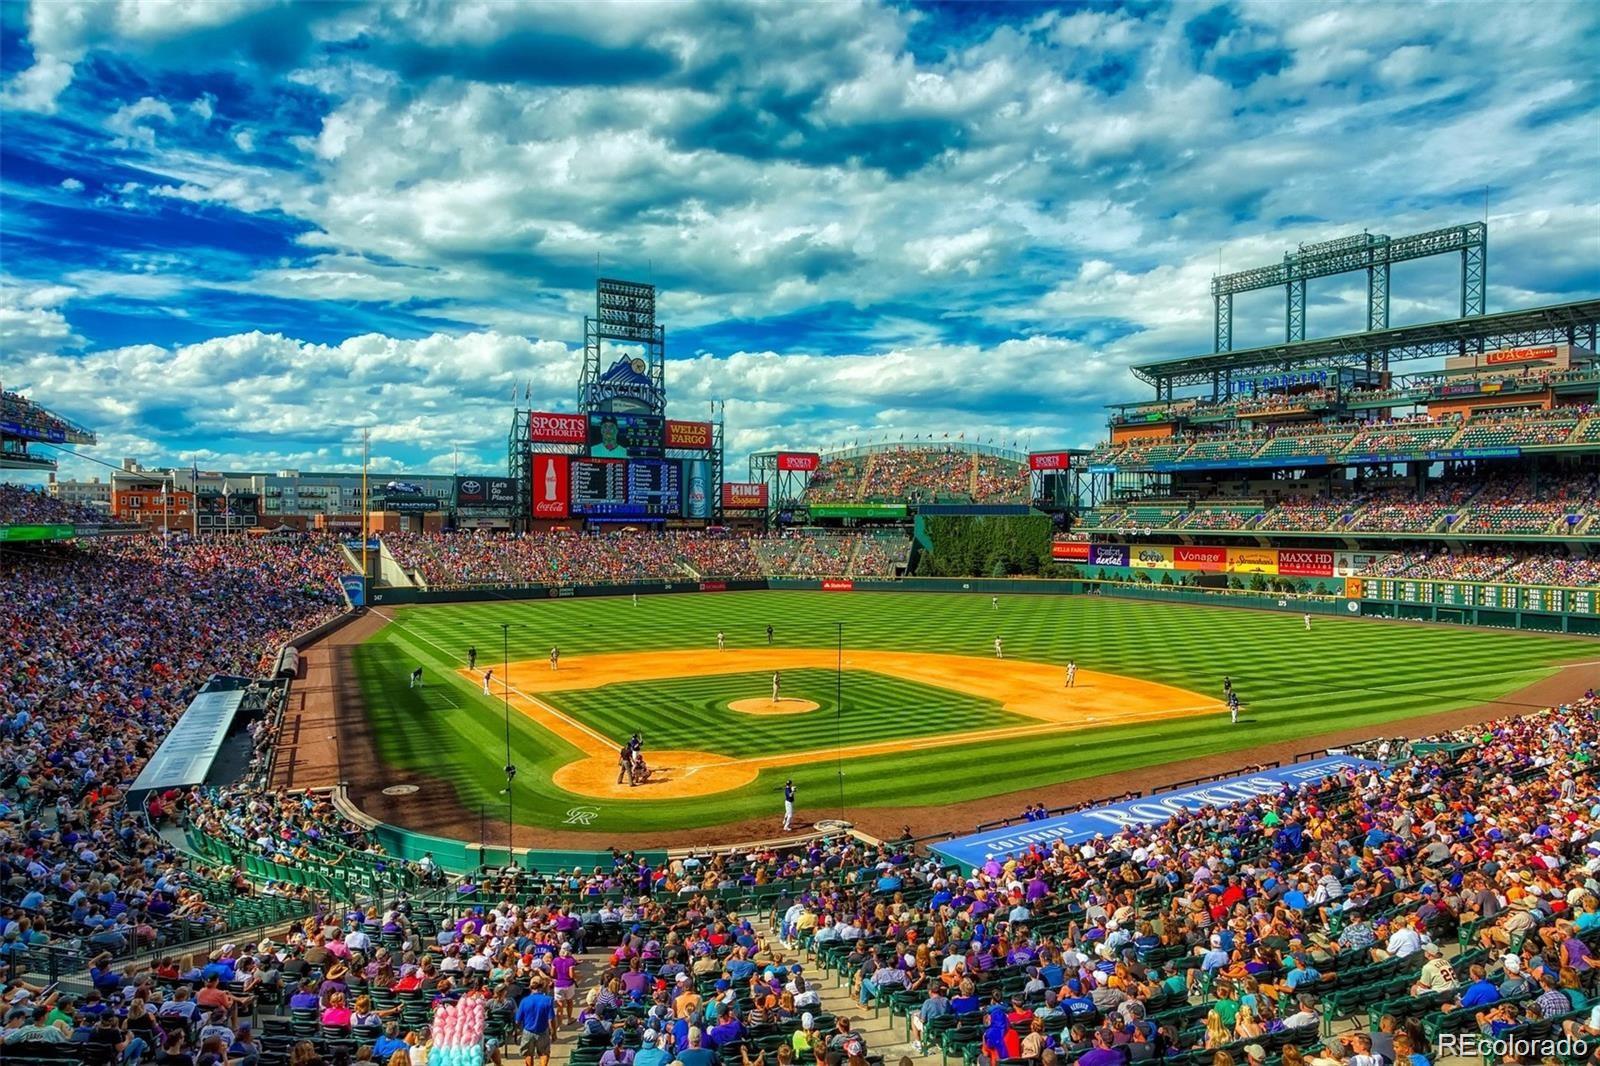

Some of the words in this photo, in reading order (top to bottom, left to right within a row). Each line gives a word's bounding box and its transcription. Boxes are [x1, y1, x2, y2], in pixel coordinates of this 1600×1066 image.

[1489, 349, 1535, 361] TUACA
[585, 383, 668, 408] ROCKIES
[532, 416, 585, 430] SPORTS
[532, 428, 585, 437] AUTHORITY
[671, 425, 706, 435] WELLS
[671, 434, 706, 445] FARGO
[786, 457, 811, 465] SPORTS
[731, 485, 760, 495] KING
[730, 496, 760, 505] Soopers
[537, 501, 564, 512] Coca-Cola
[1139, 550, 1164, 562] Coors
[1180, 551, 1219, 562] Vonage
[1280, 553, 1312, 563] MAXX
[1315, 554, 1332, 564] HD
[1081, 777, 1296, 826] ROCKIES
[987, 826, 1074, 851] COLORADO
